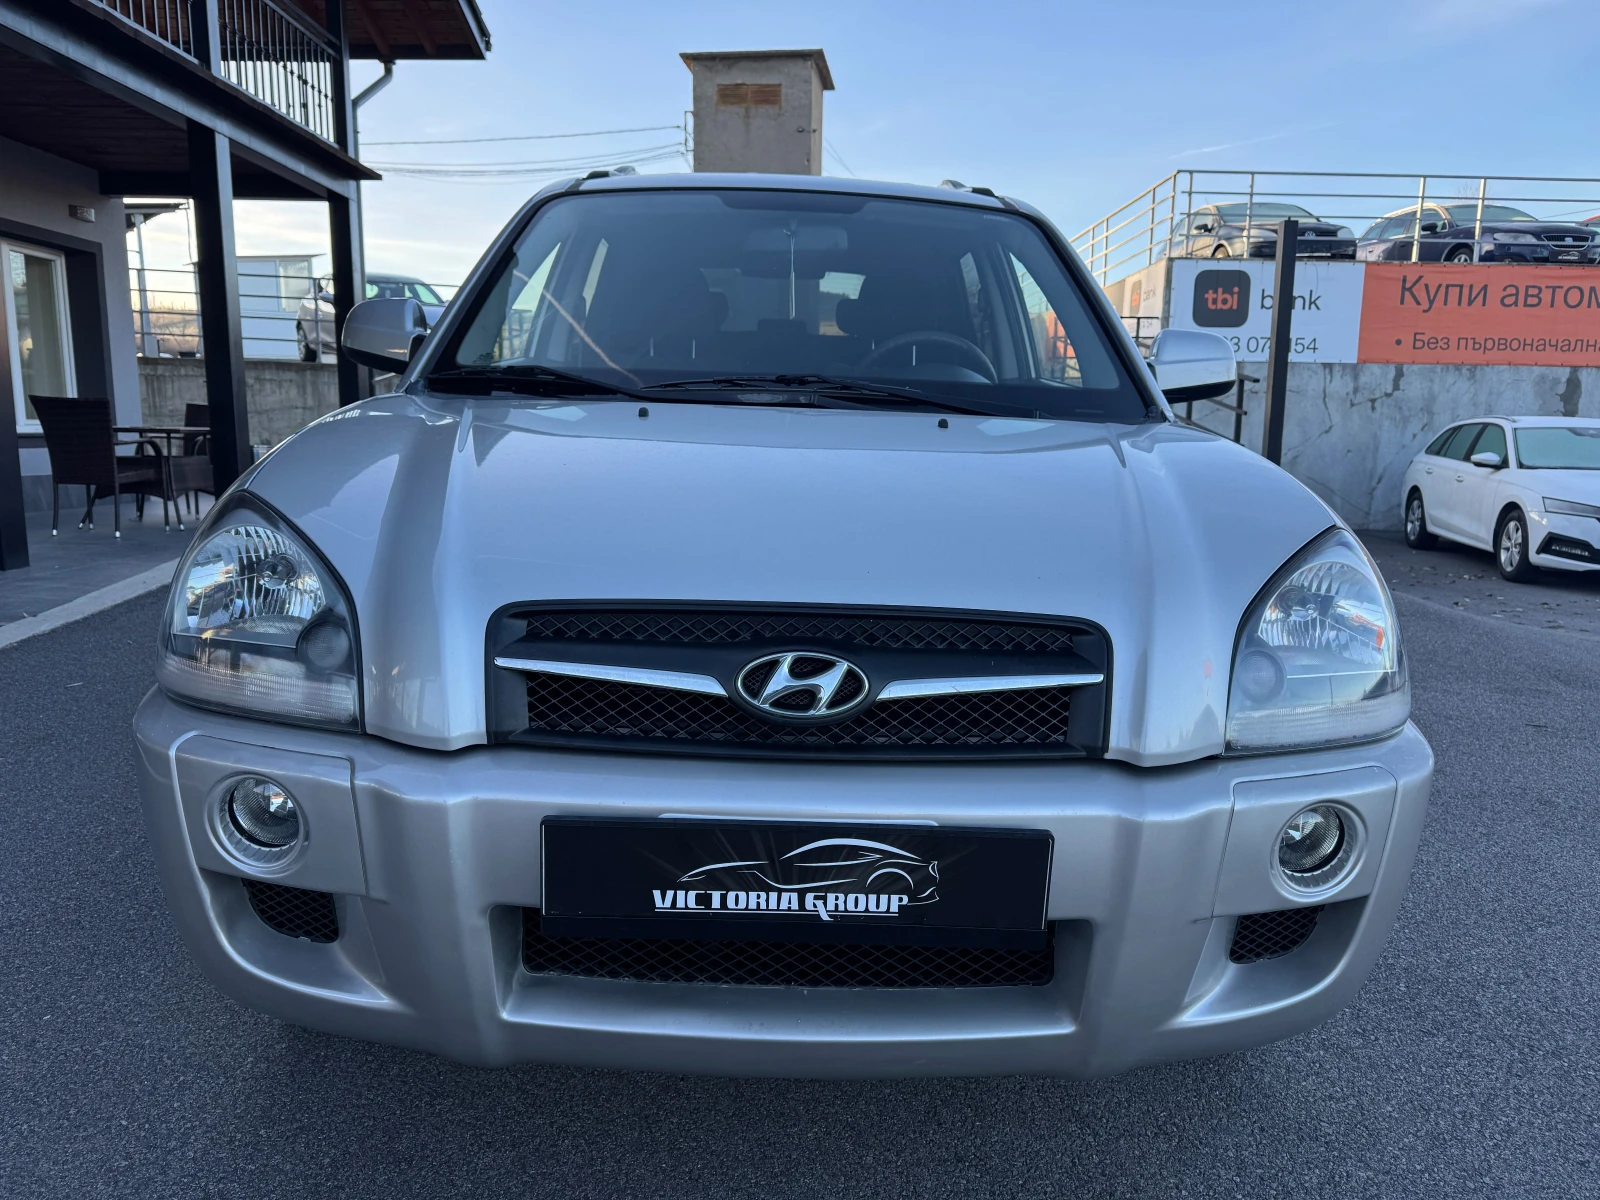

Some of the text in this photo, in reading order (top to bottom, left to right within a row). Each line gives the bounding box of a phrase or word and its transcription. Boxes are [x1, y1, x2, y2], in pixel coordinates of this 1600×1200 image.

[1204, 286, 1321, 311] tbi bnk
[1400, 275, 1489, 314] Купи
[1412, 332, 1600, 355] Без първоначалн
[652, 889, 909, 921] VICTORIA GROUP
